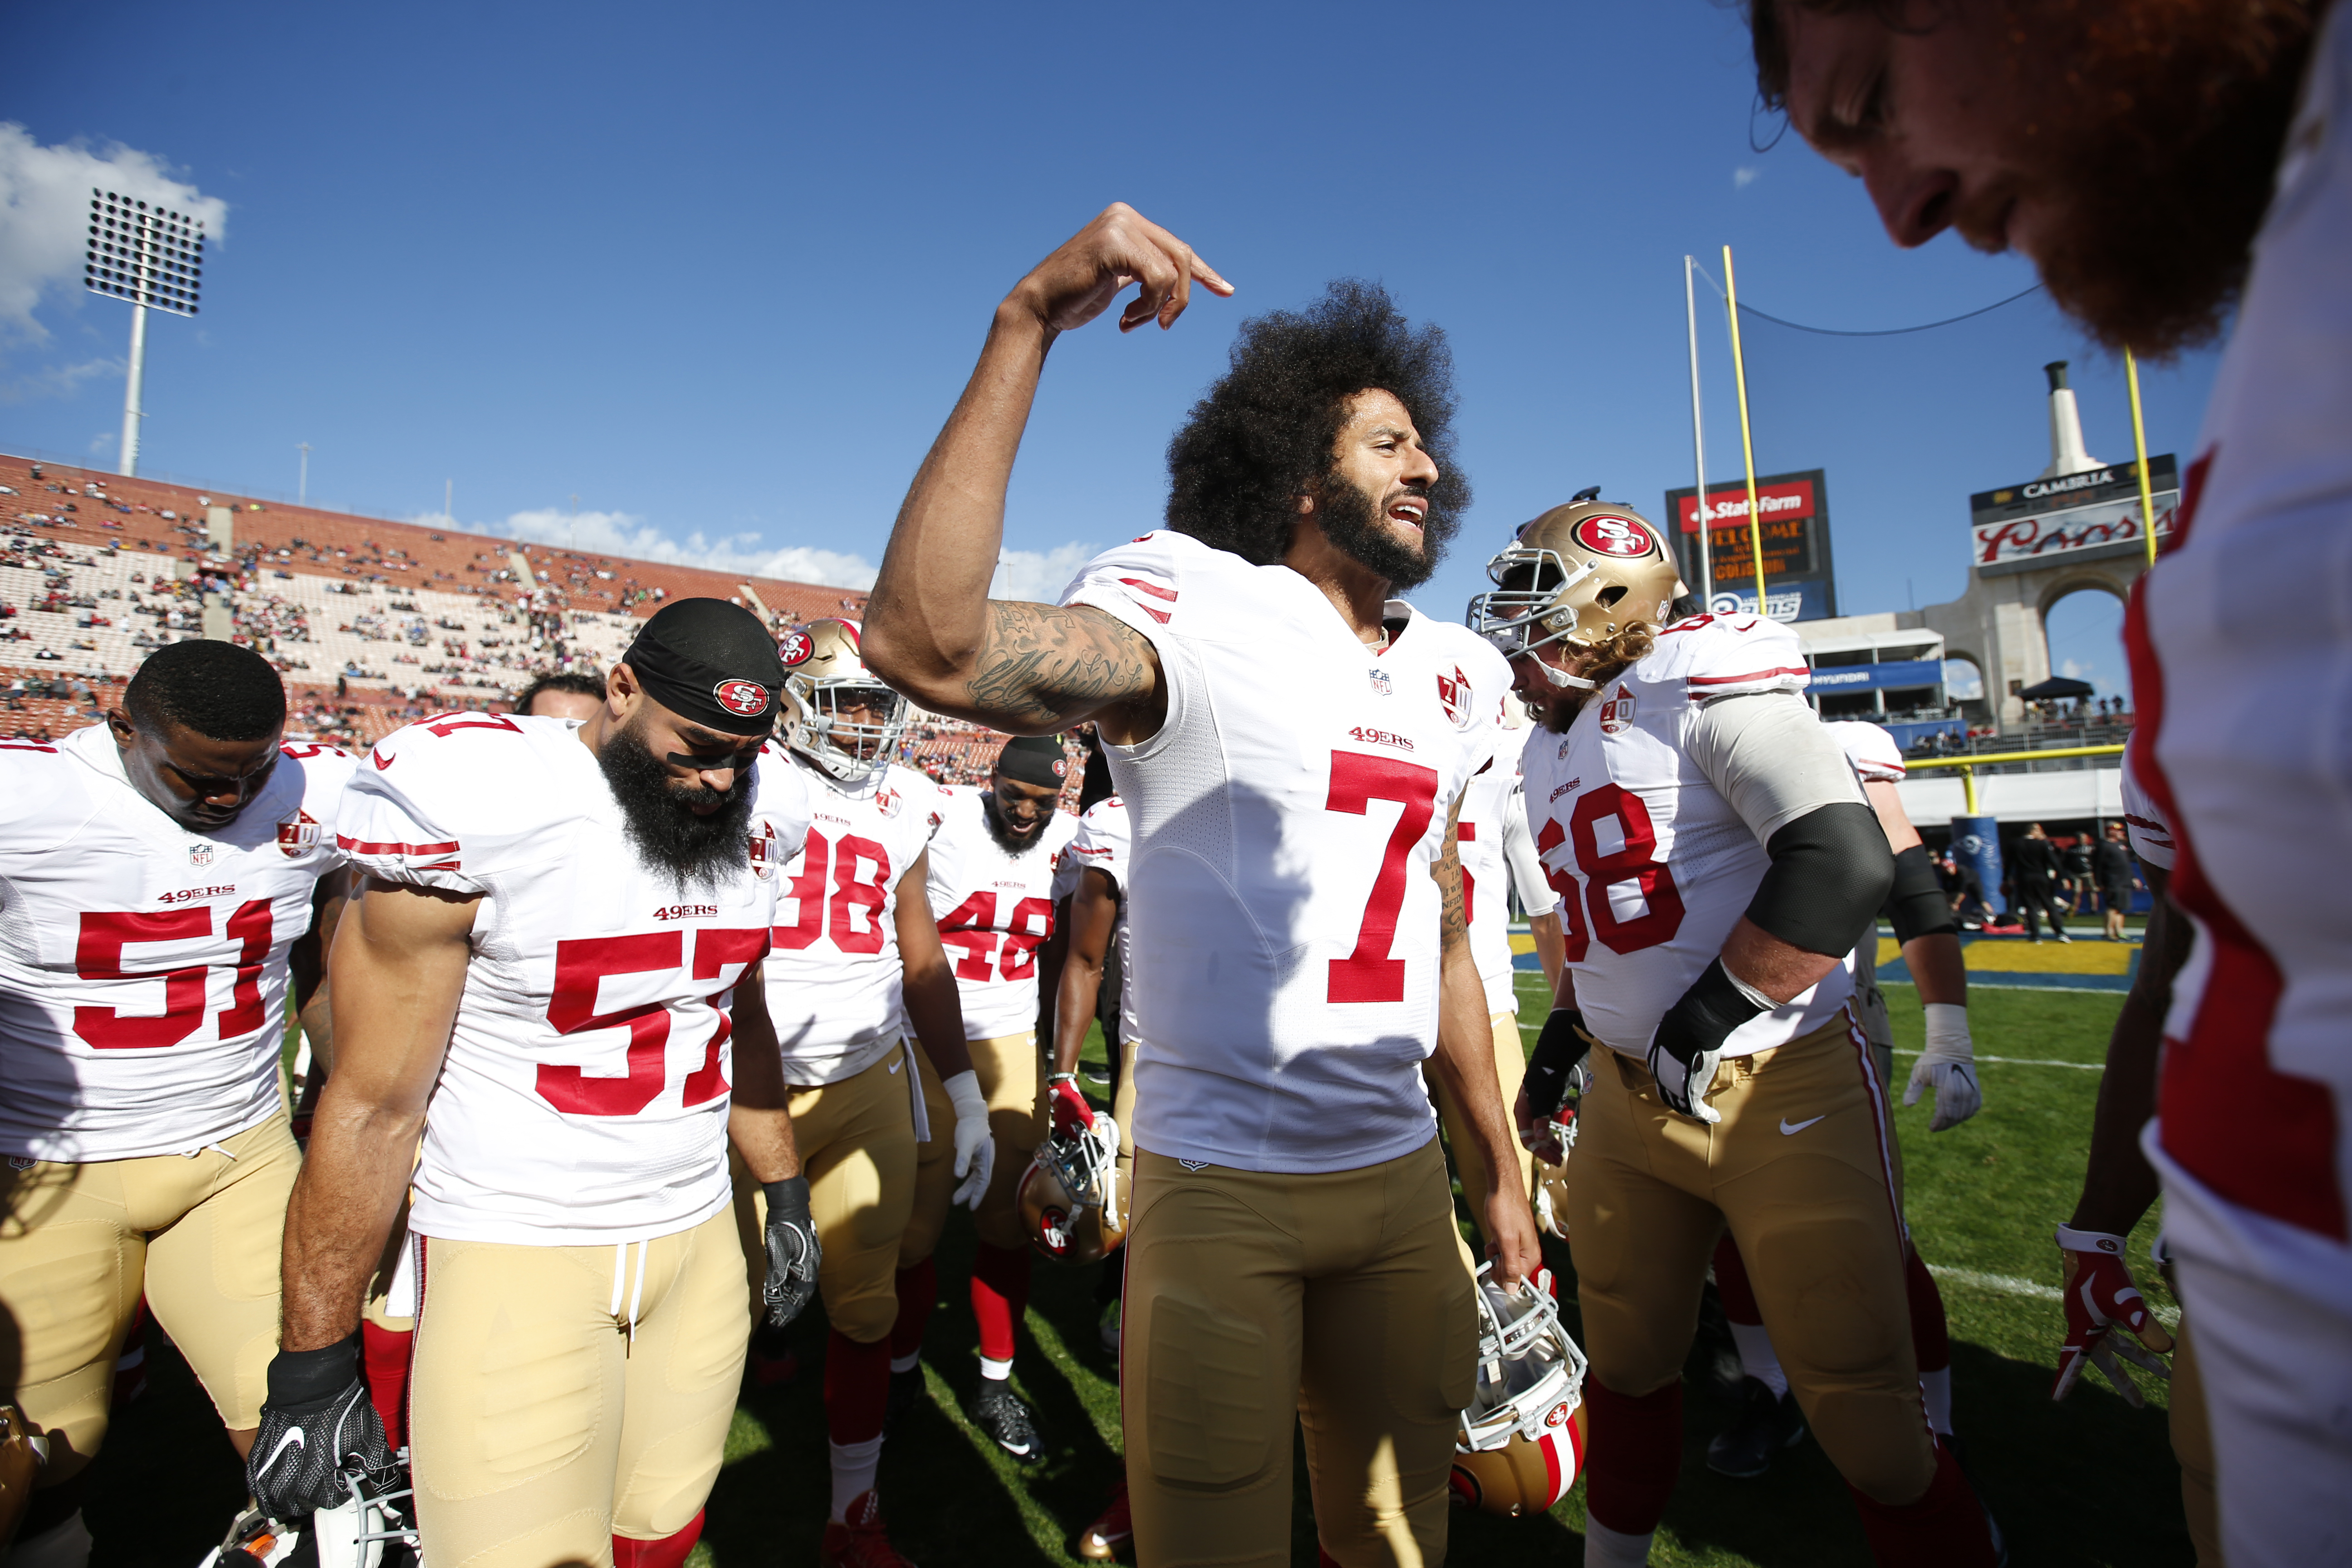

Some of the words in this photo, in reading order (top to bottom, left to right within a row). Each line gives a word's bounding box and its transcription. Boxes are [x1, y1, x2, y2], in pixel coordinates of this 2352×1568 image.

[2022, 470, 2116, 498] CAMBRIA
[1716, 499, 1757, 519] Stat
[1759, 495, 1802, 513] Farm
[1715, 558, 1786, 581] COLISUM
[1372, 679, 1391, 692] NFL
[1348, 727, 1414, 752] 49ERS
[1549, 777, 1581, 804] 49ERS
[193, 853, 212, 864] NFL
[991, 881, 1026, 890] 49ERS
[1326, 749, 1438, 1003] 7
[158, 884, 235, 904] 49ERS
[653, 905, 718, 921] 49ERS
[73, 897, 274, 1049] 51
[535, 927, 773, 1115] 57
